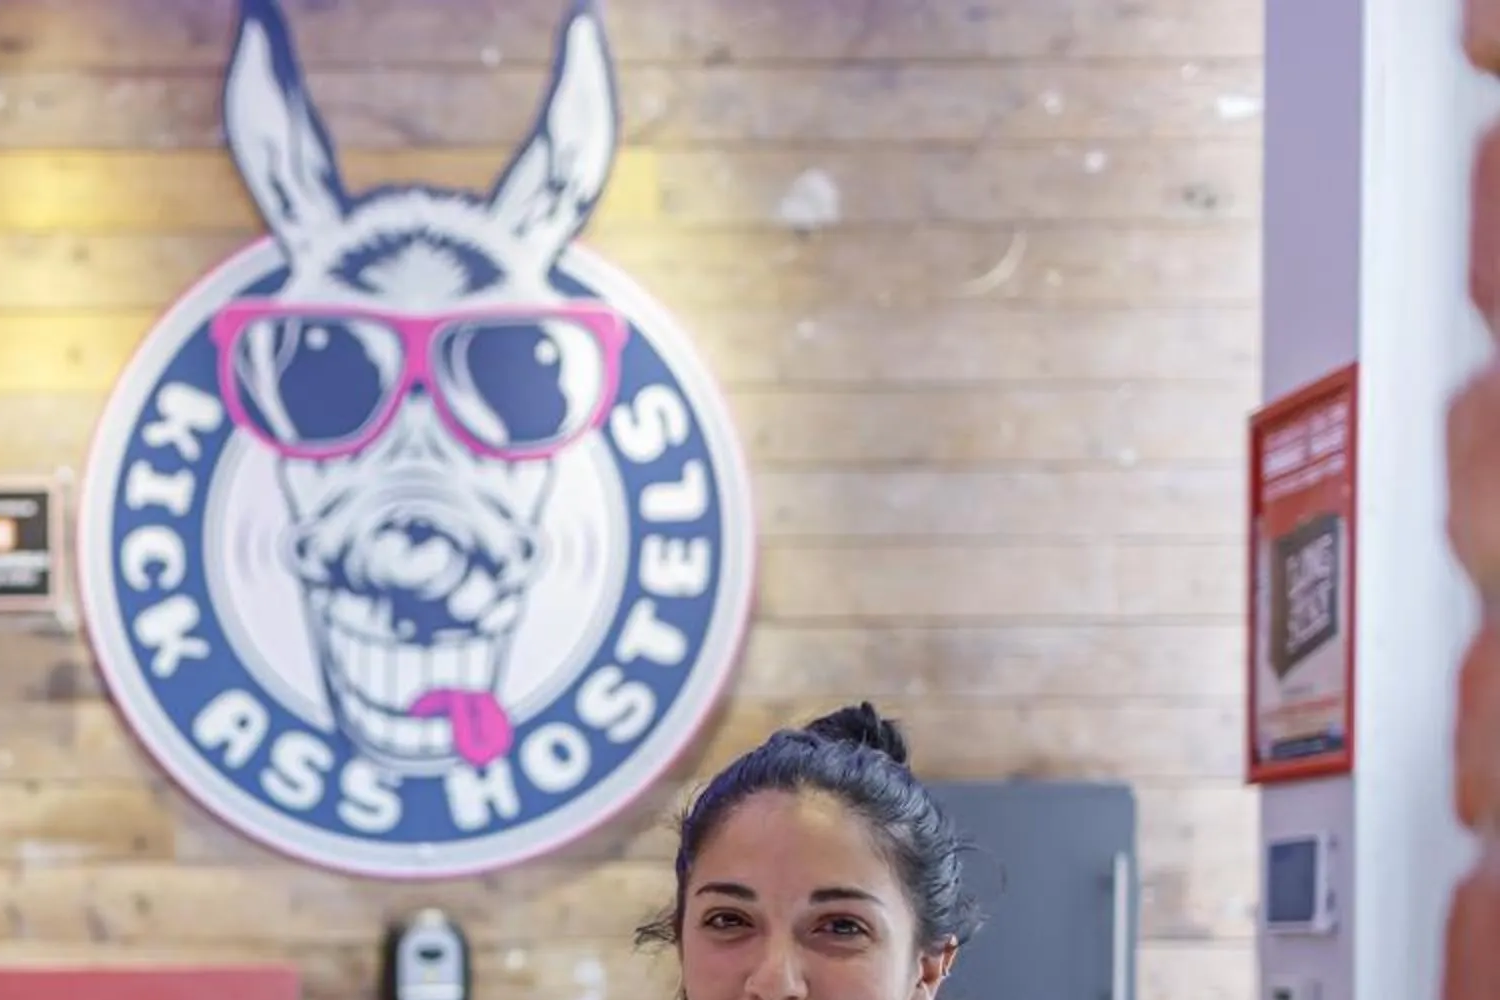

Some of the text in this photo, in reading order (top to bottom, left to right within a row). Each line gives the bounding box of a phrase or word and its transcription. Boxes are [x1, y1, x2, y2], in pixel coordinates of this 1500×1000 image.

[119, 381, 711, 833] KICK ASS HOSTELS
